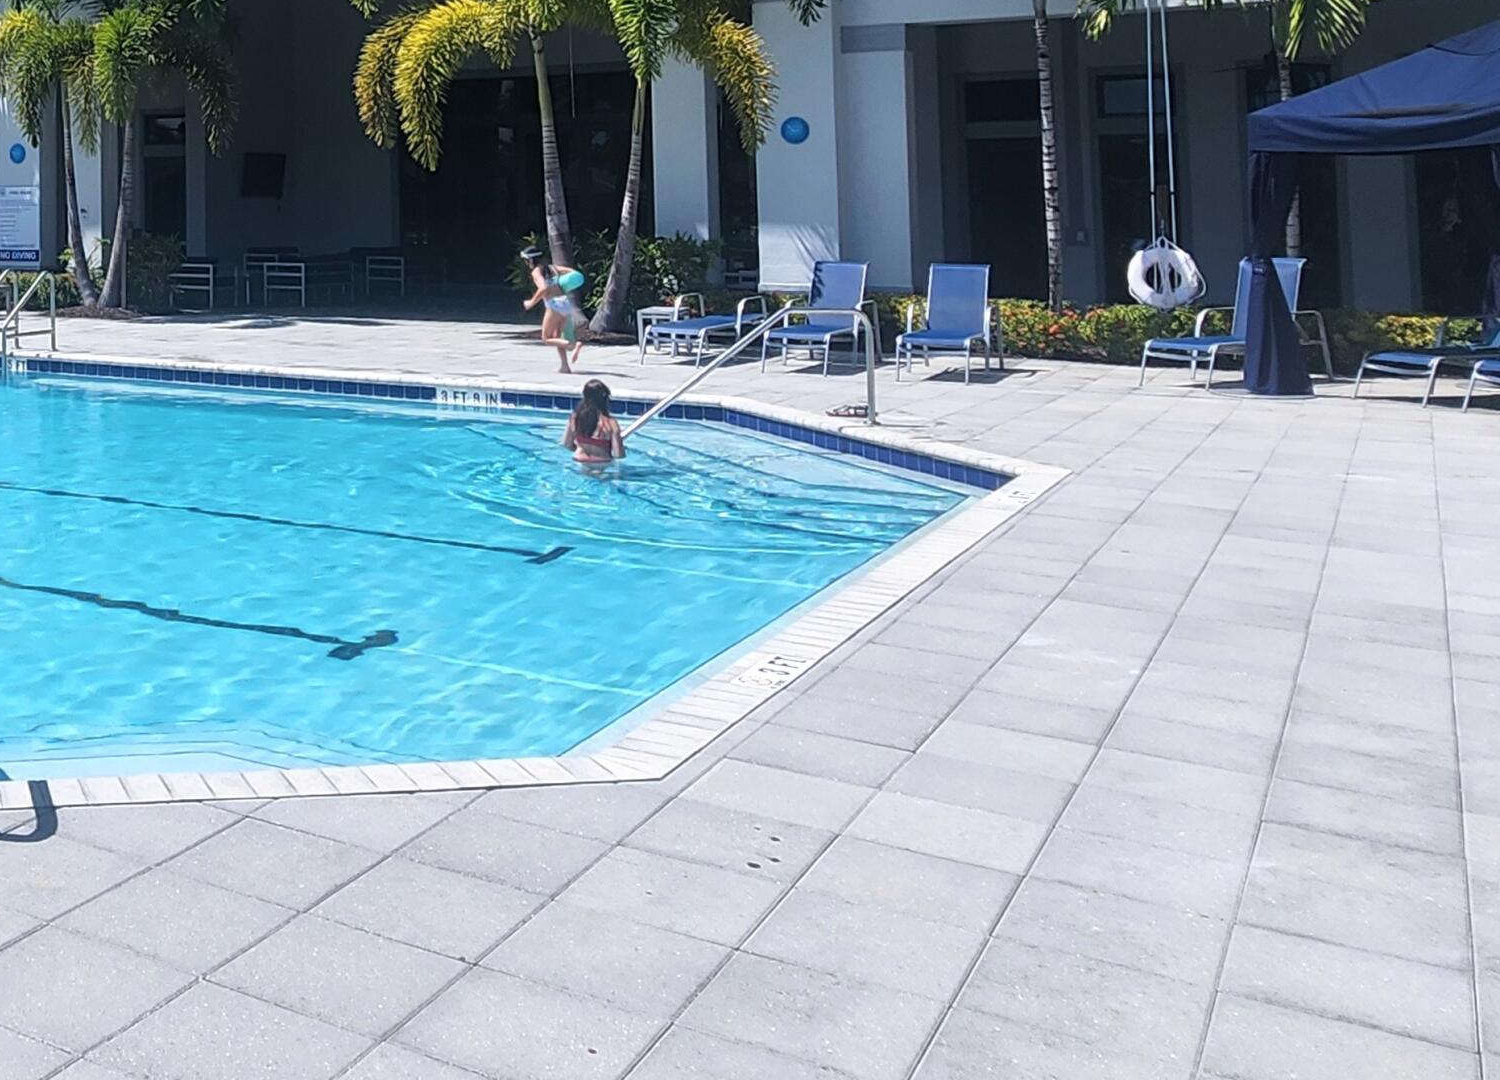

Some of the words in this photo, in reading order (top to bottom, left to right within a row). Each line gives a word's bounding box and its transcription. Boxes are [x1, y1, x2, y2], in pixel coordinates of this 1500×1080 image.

[0, 251, 10, 260] NO
[11, 251, 37, 260] DIVING
[16, 360, 26, 371] FT
[453, 391, 467, 404] FT
[485, 392, 498, 406] IN
[767, 656, 807, 669] FT
